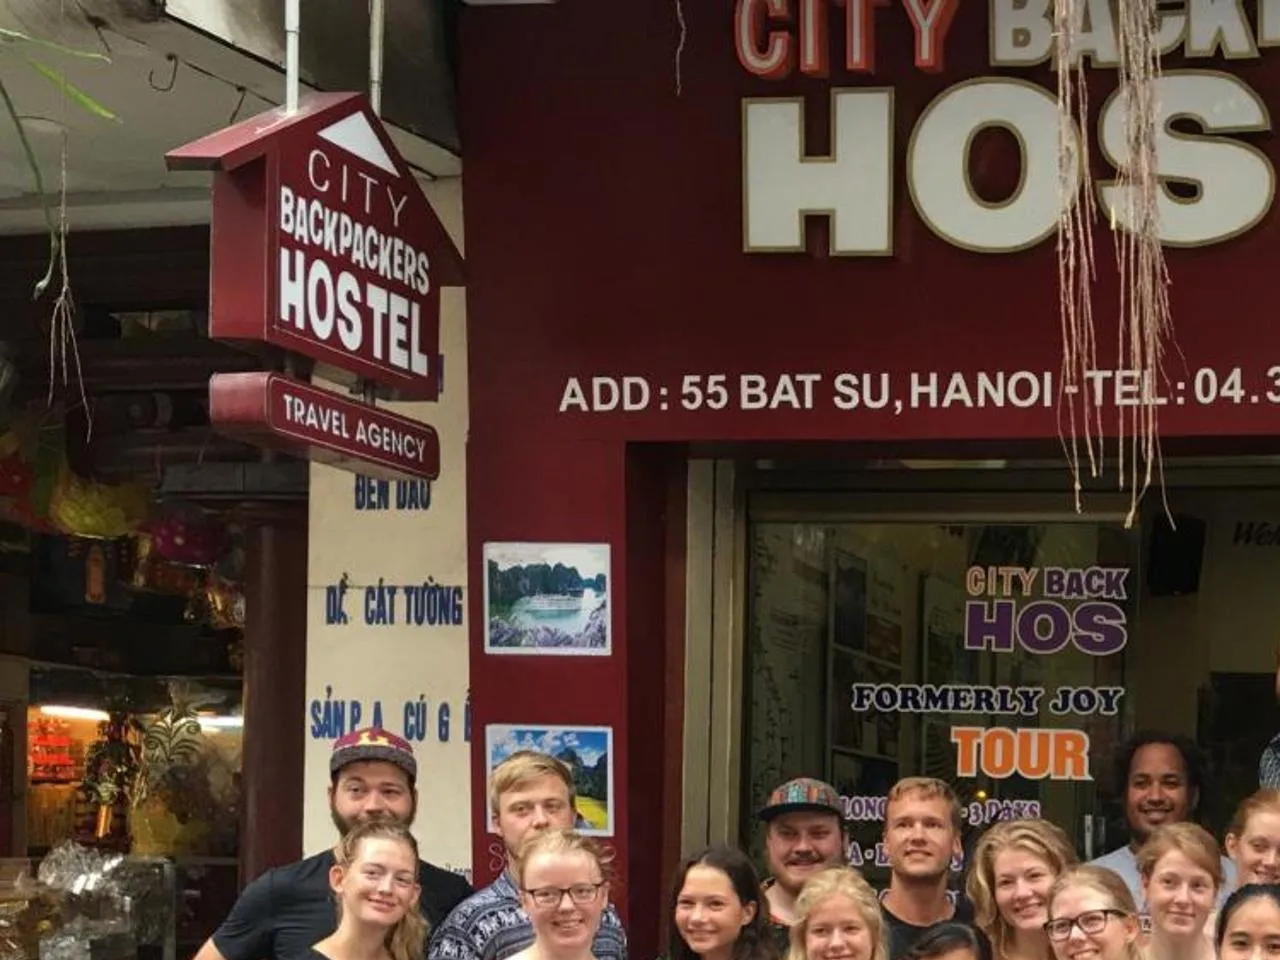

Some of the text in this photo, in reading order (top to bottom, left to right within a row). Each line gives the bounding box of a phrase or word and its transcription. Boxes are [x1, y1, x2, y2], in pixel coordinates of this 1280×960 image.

[734, 0, 957, 77] CITY
[308, 149, 408, 228] CITY
[280, 186, 429, 295] BACKPACKERS
[280, 247, 428, 376] HOSTEL
[681, 375, 729, 410] 55
[740, 374, 822, 410] BAT
[283, 394, 426, 461] TRAVEL AGENCY
[966, 565, 1130, 600] CITY BACK
[964, 600, 1128, 656] HOS
[853, 683, 1124, 715] FORMERLY JOY
[950, 726, 1094, 782] TOUR
